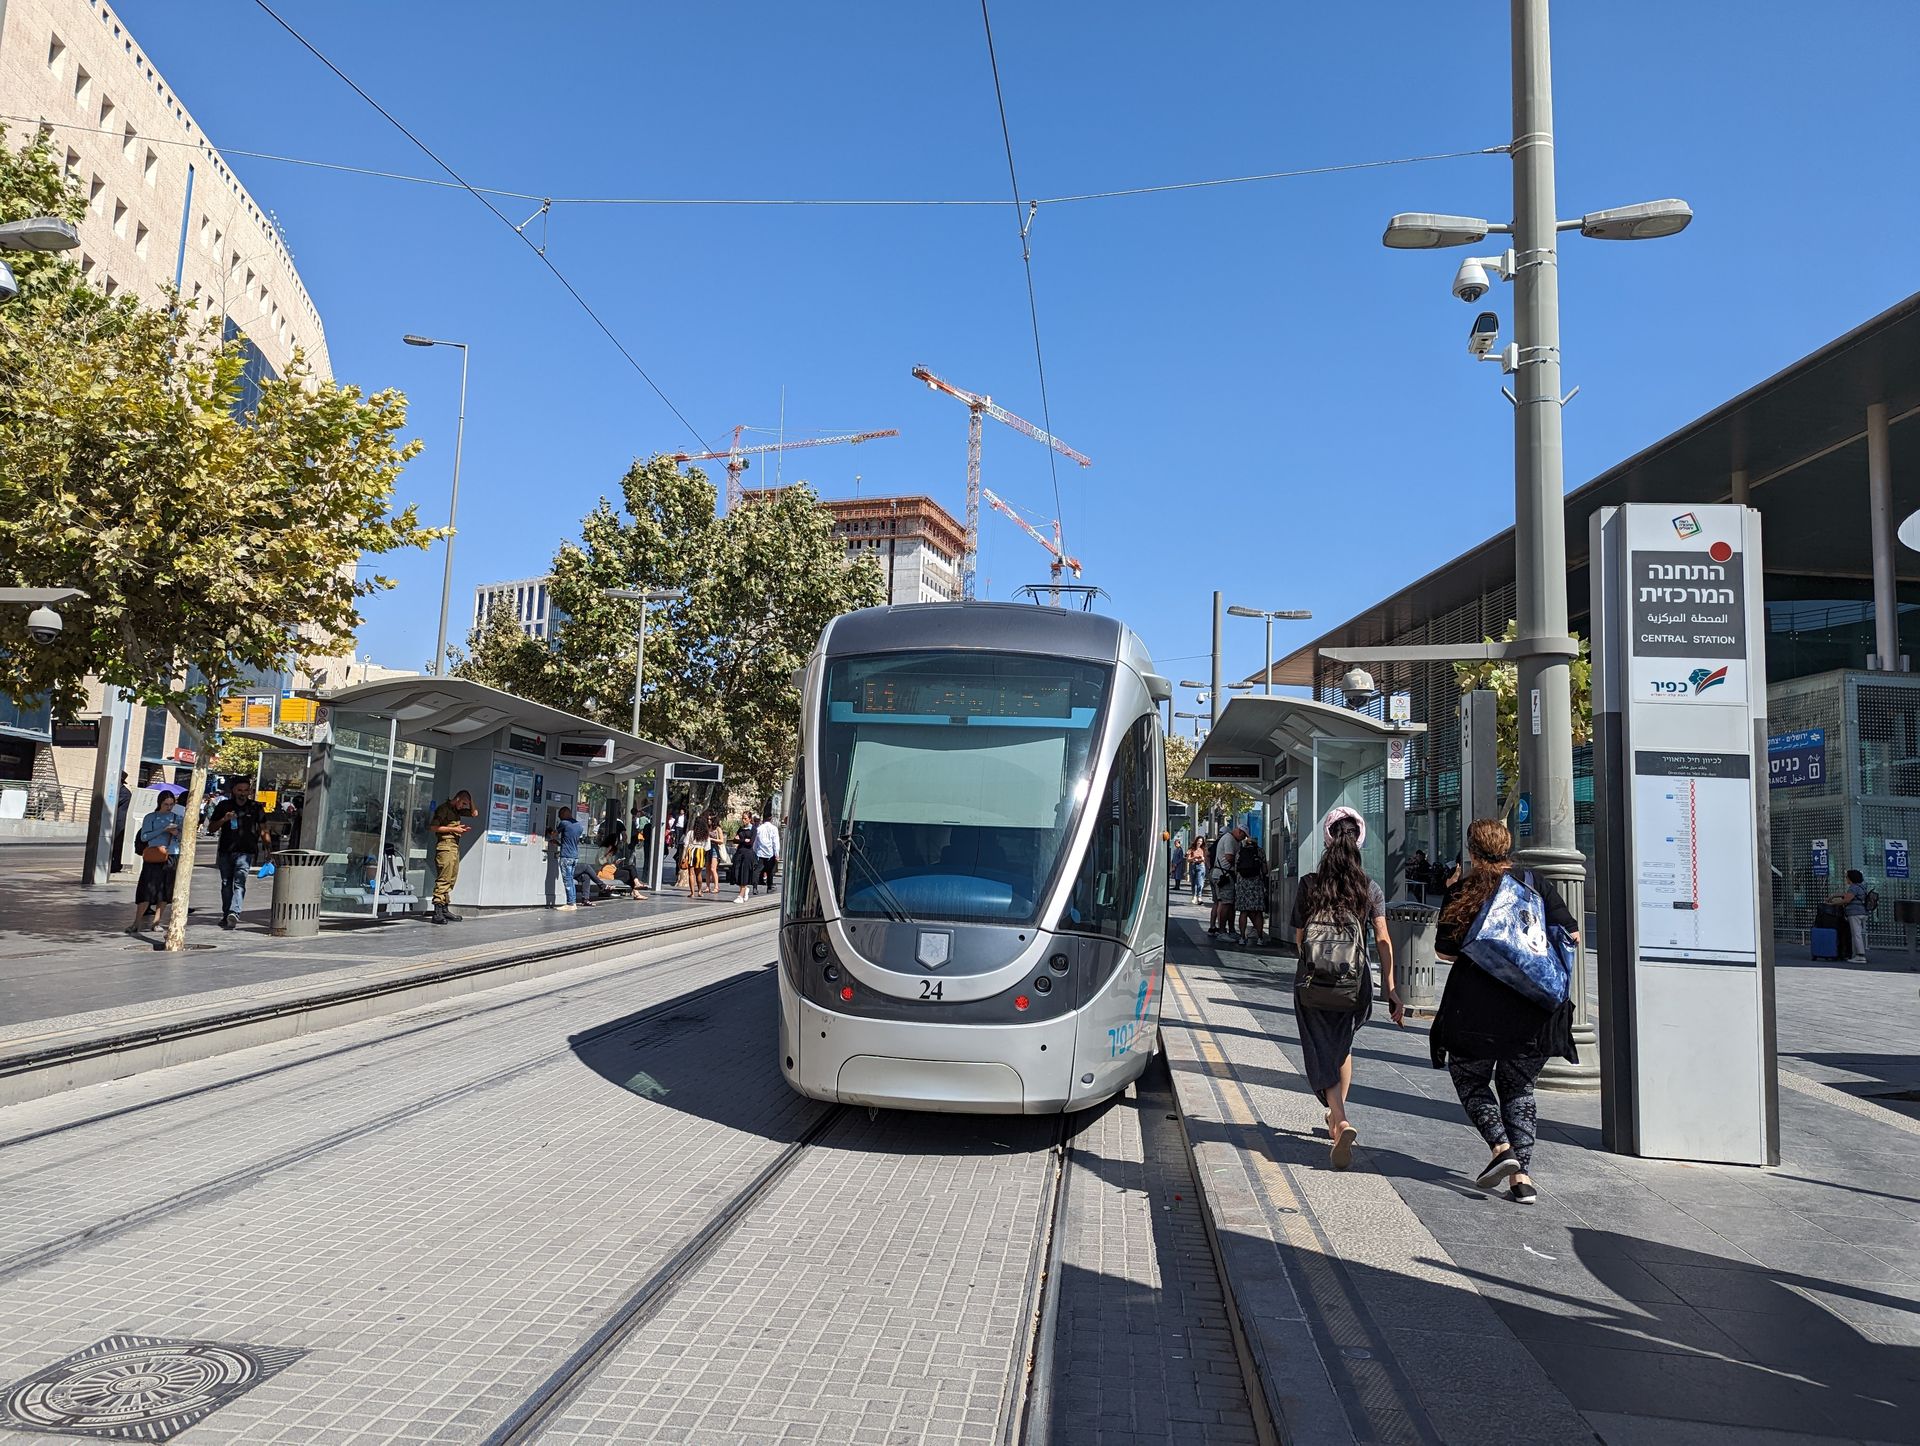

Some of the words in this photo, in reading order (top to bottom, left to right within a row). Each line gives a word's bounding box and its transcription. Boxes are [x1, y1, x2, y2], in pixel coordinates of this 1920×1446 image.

[1648, 564, 1725, 581] התחנה
[1639, 586, 1734, 604] המרכזית
[1647, 613, 1686, 625] المركزية
[1690, 614, 1728, 624] المحطة
[1641, 634, 1688, 644] CENTRAL
[1693, 635, 1736, 645] STATION
[1650, 681, 1688, 693] כפיר
[1786, 733, 1808, 743] ירושלים
[1703, 757, 1722, 765] לכיוון
[1768, 757, 1800, 773] כניס
[1768, 776, 1787, 784] RANCE
[919, 979, 943, 1000] 24
